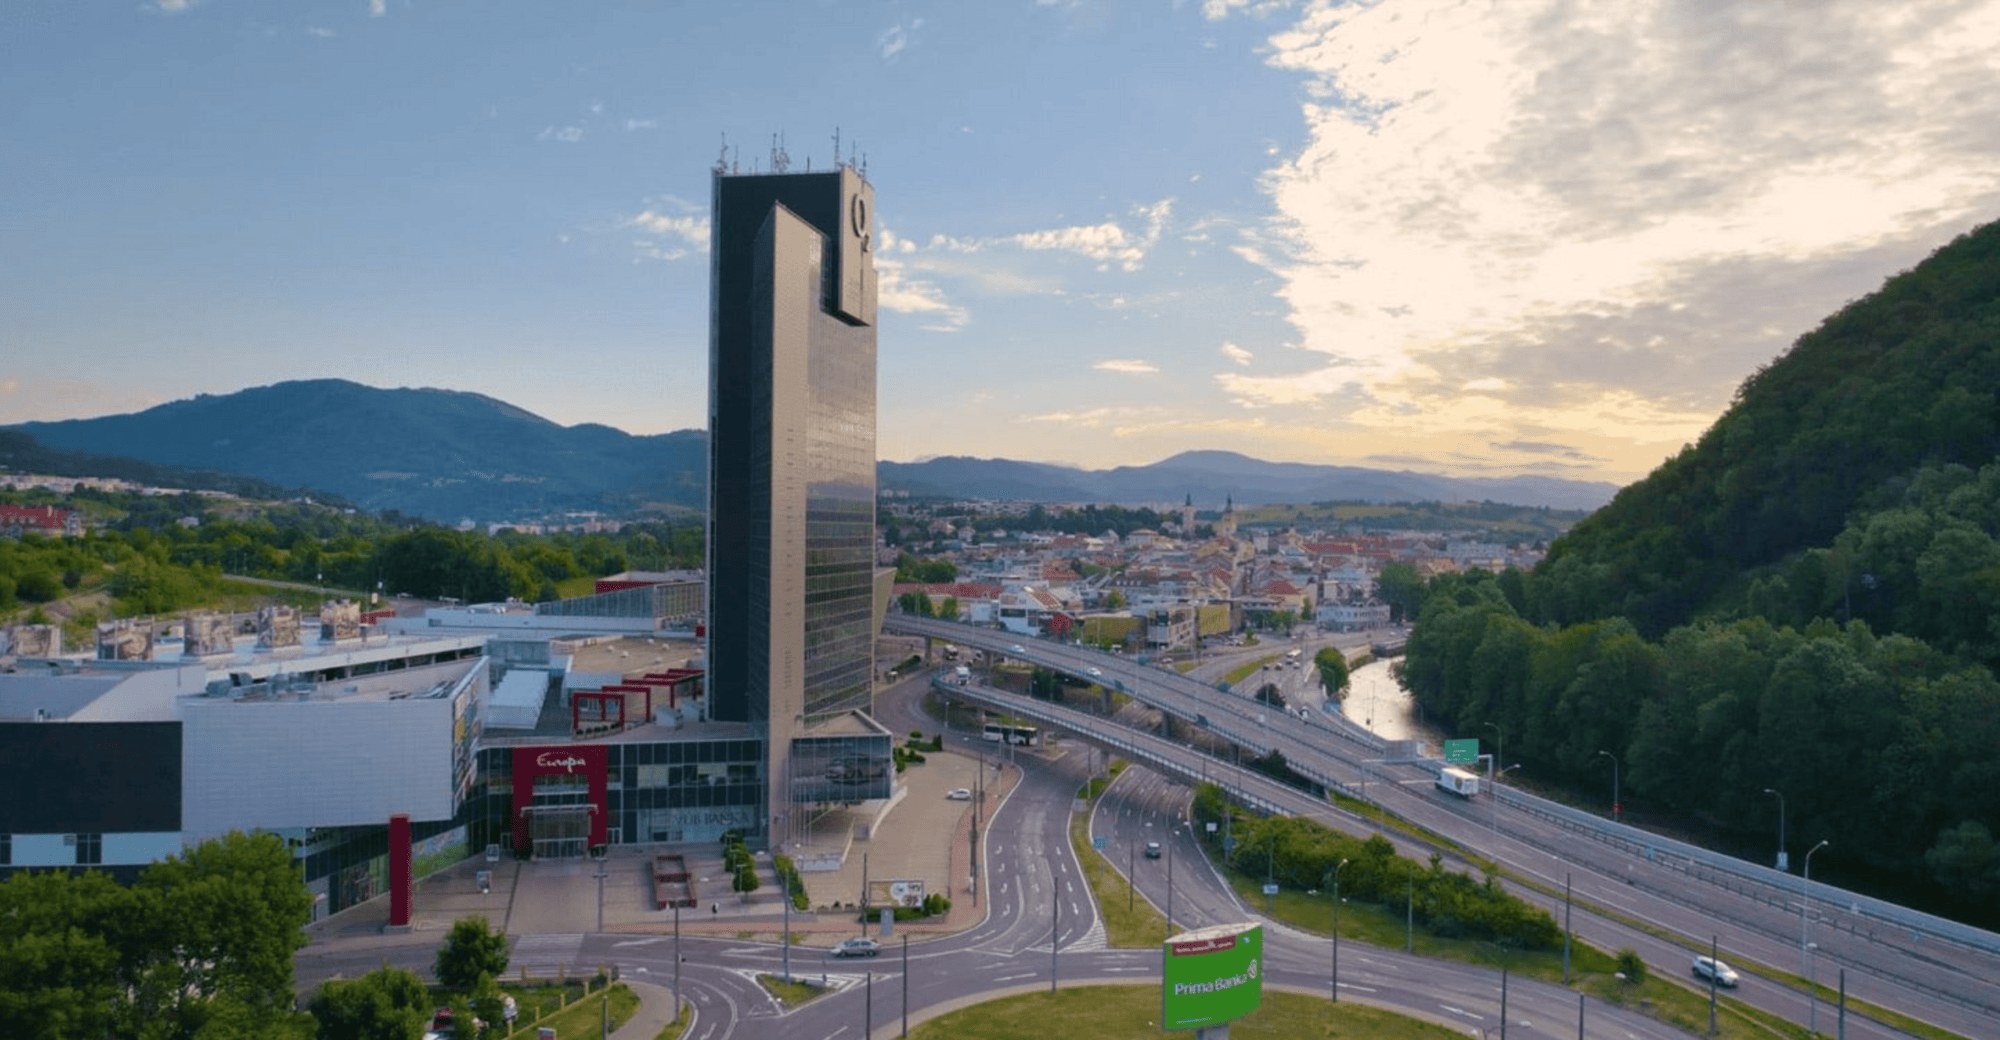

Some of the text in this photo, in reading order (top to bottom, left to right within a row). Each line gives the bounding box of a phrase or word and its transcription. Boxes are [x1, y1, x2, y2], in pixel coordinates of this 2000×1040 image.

[536, 751, 587, 774] Europa
[1174, 974, 1248, 996] Prima Banka
